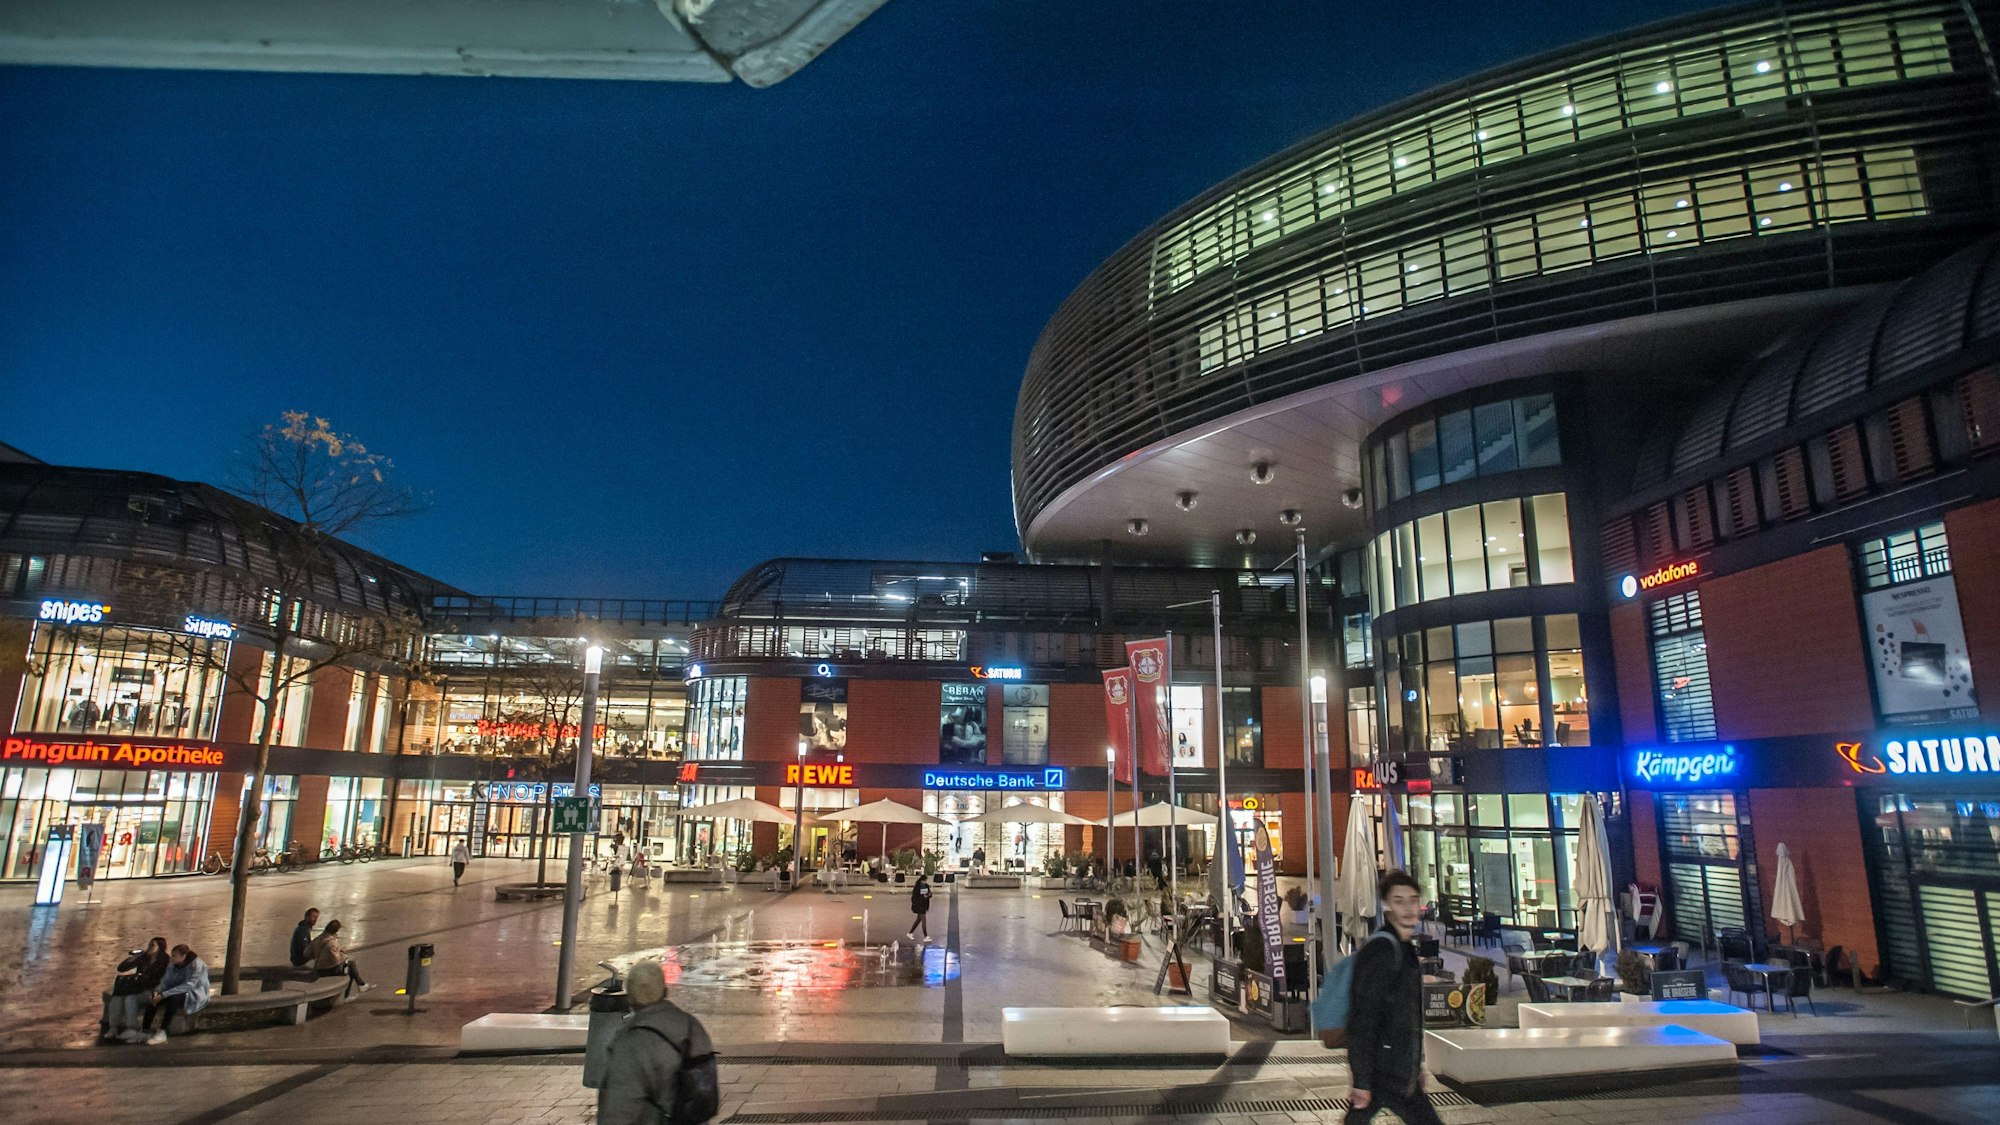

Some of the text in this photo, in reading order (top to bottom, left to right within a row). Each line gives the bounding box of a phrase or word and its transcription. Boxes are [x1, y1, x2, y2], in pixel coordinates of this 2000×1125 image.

[1640, 561, 1697, 589] vodafone
[40, 600, 102, 624] snipes
[184, 615, 232, 638] snipes
[987, 667, 1022, 679] SATURN
[3, 739, 224, 766] Pinguin Apotheke
[787, 764, 853, 785] REWE
[1636, 751, 1734, 782] Kämpgen
[925, 773, 1034, 787] Deutsche Bank
